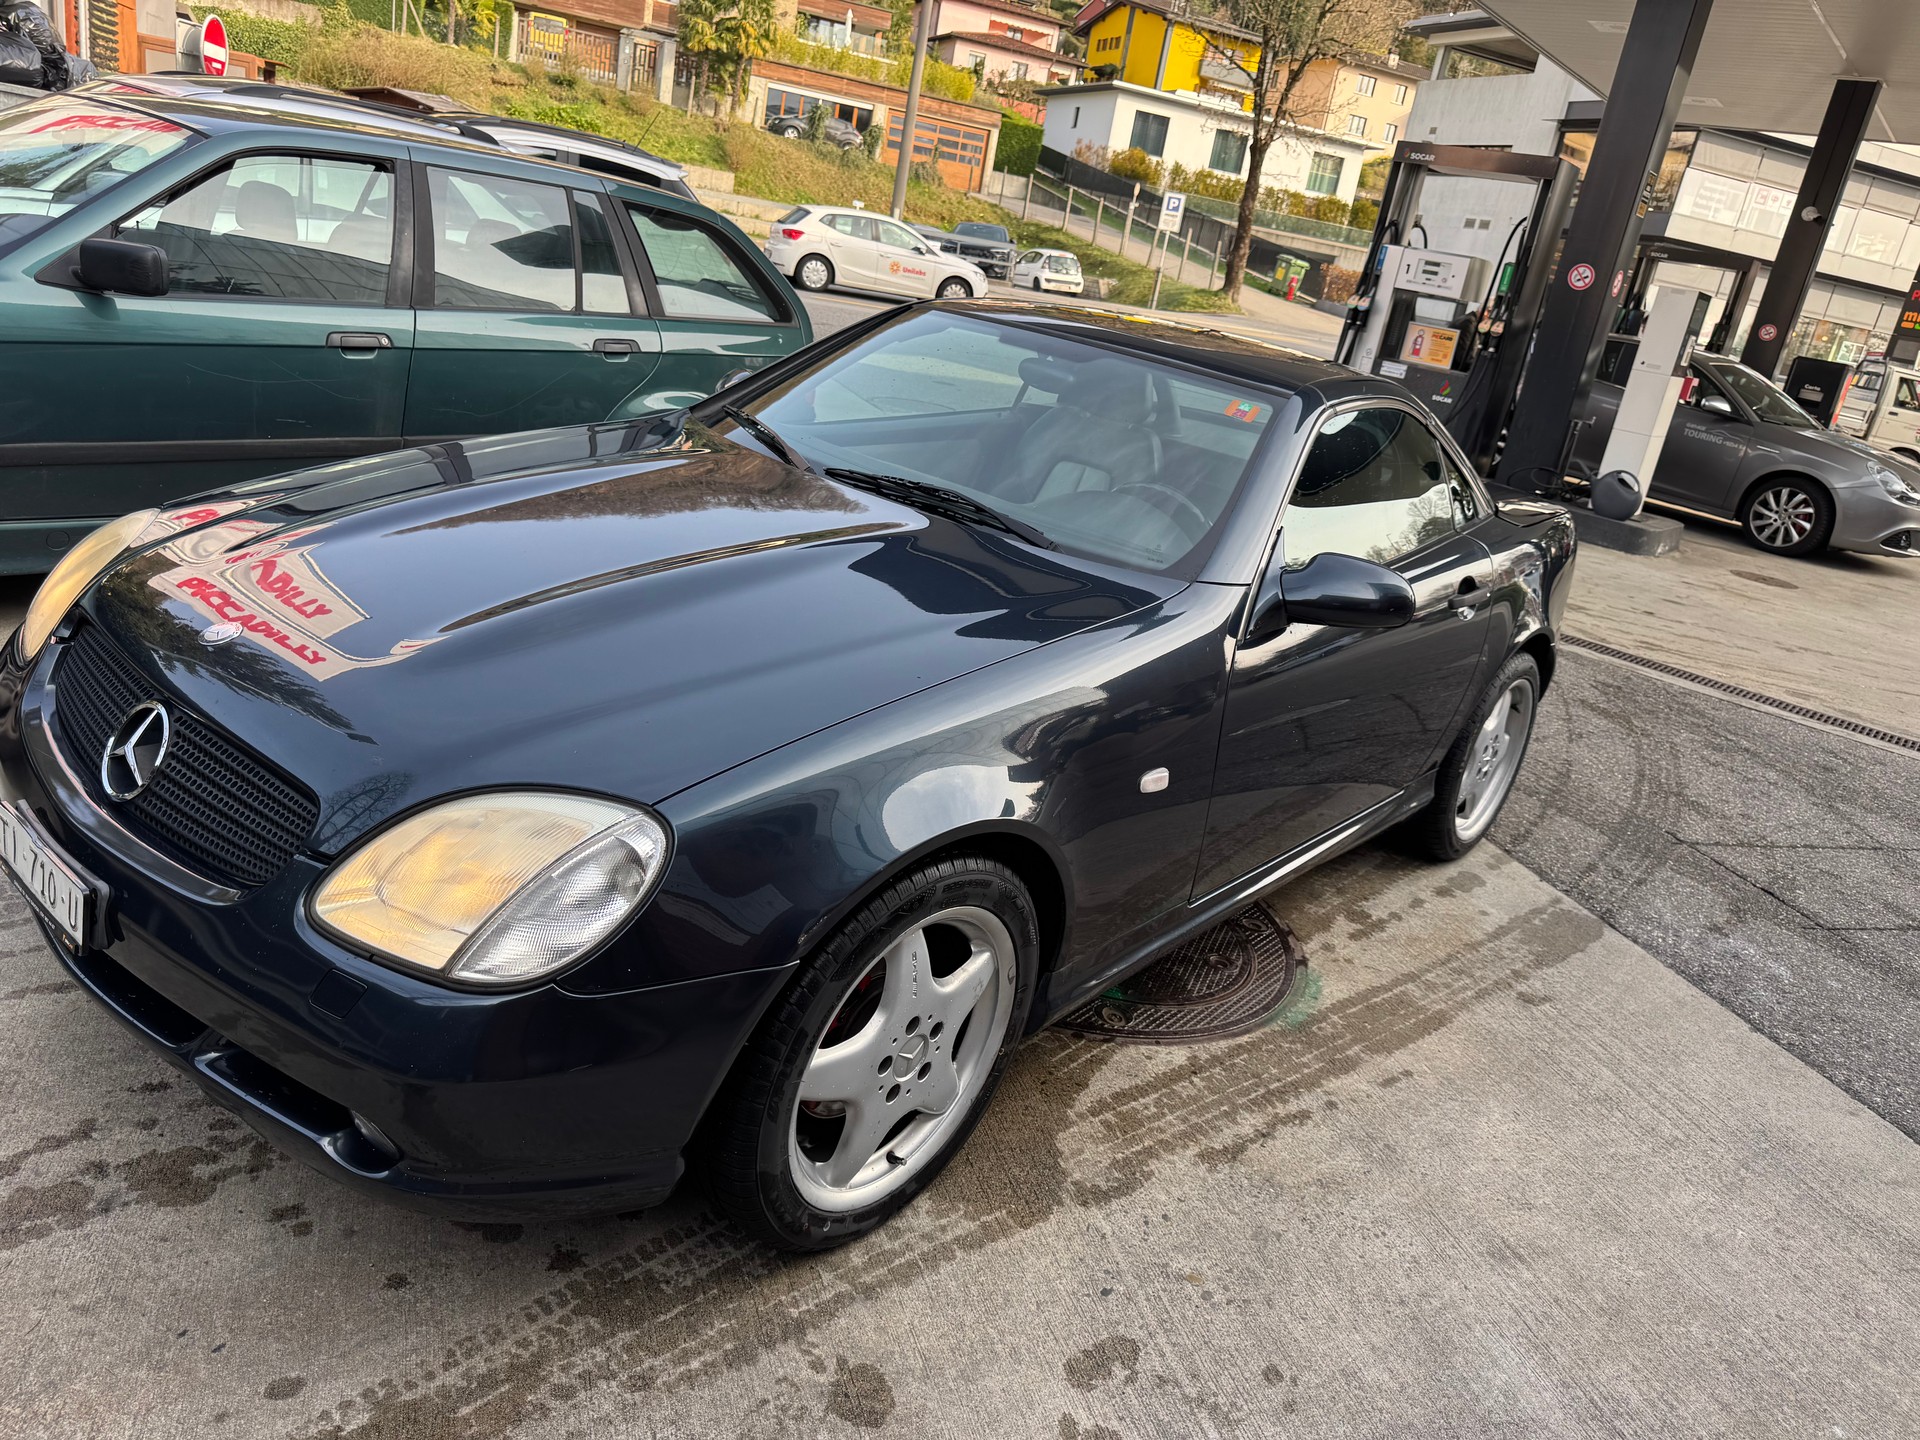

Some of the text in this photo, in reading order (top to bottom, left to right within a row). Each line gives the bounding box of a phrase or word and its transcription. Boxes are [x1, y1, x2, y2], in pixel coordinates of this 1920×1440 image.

[1410, 152, 1435, 161] SOCAR
[1168, 198, 1180, 210] P
[1431, 394, 1453, 404] SOCAR
[1684, 428, 1724, 444] TOURING
[29, 845, 57, 909] 710
[68, 887, 78, 932] U
